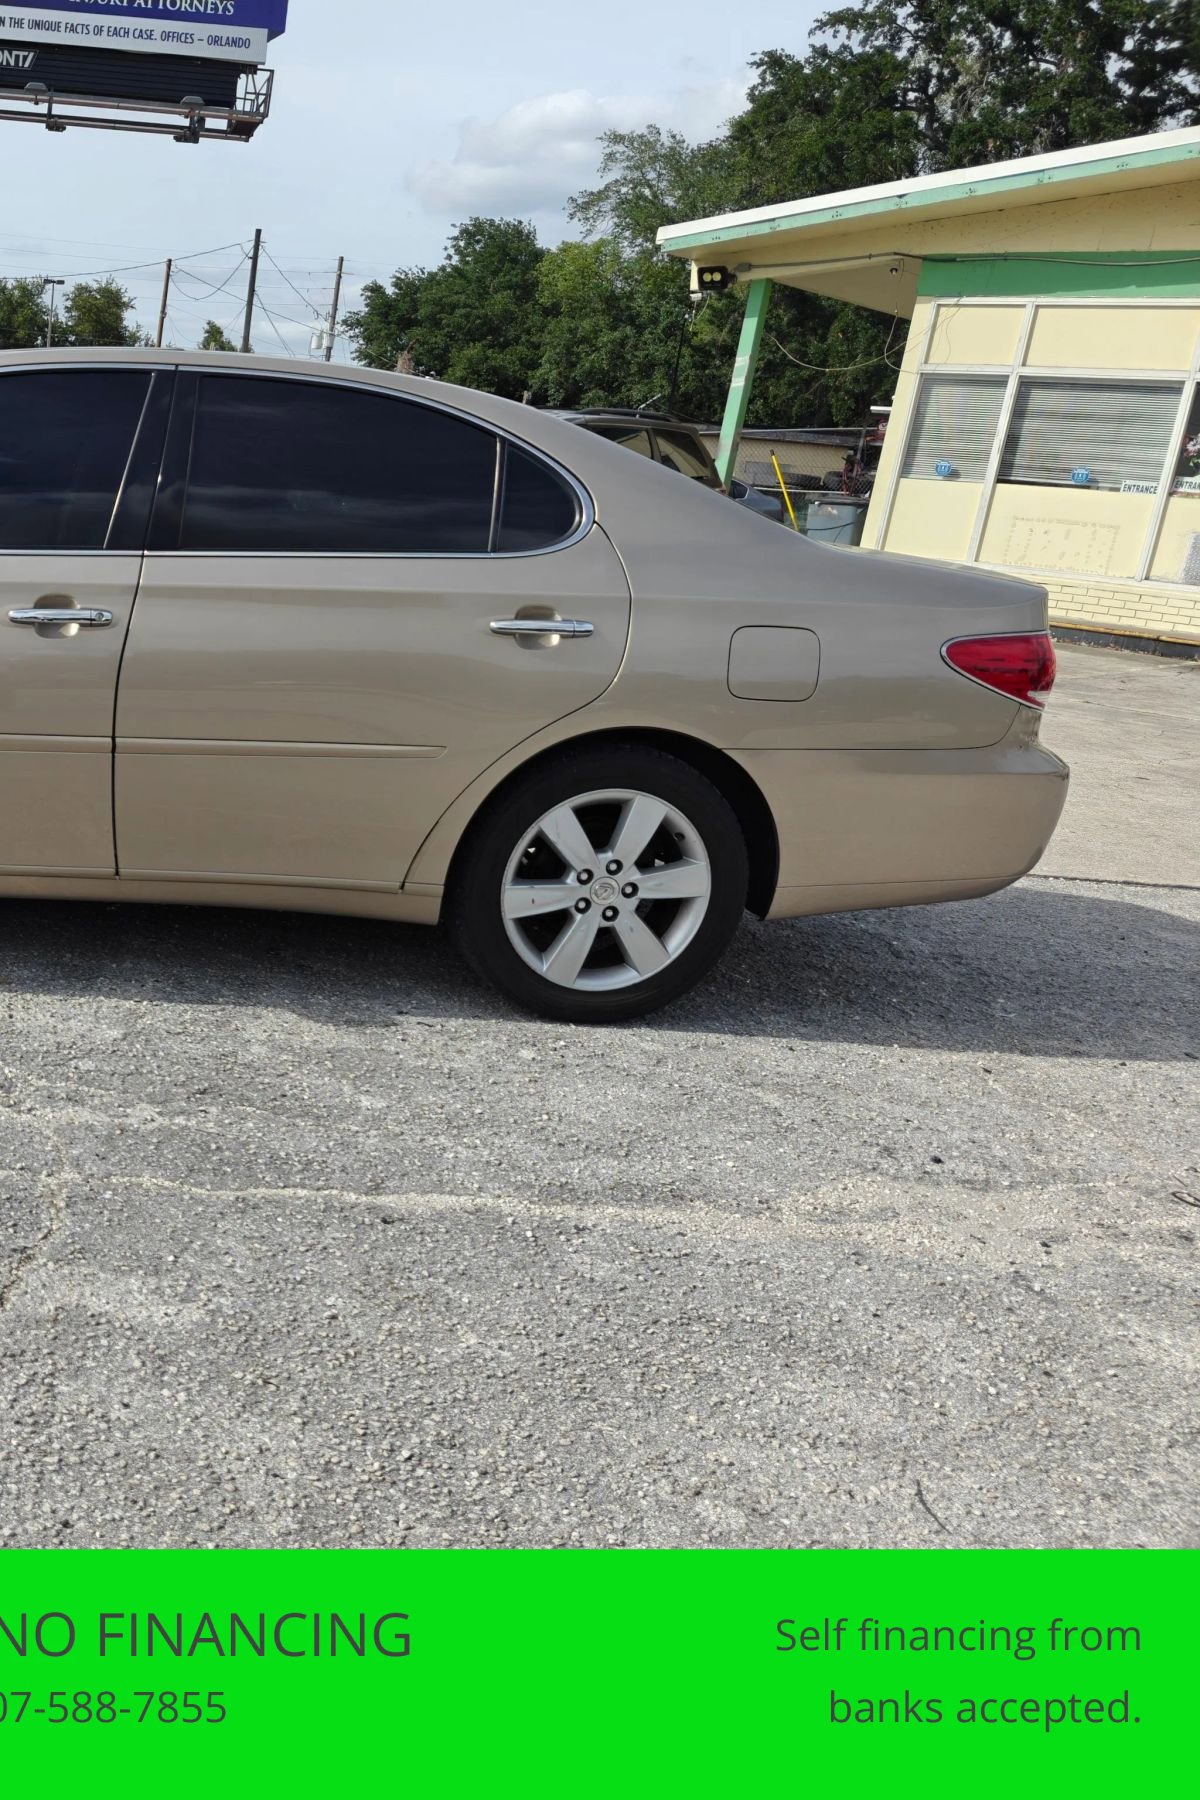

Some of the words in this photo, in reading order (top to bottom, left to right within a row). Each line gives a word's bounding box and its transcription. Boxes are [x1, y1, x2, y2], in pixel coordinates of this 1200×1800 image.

[8, 16, 25, 29] THE
[27, 18, 62, 32] UNIQUE
[64, 22, 90, 36] FACTS
[93, 24, 105, 37] OF
[107, 25, 130, 39] EACH
[132, 28, 158, 41] CASE.
[160, 30, 195, 45] OFFICES
[207, 34, 251, 49] ORLANDO
[1123, 484, 1157, 494] ENTRANCE
